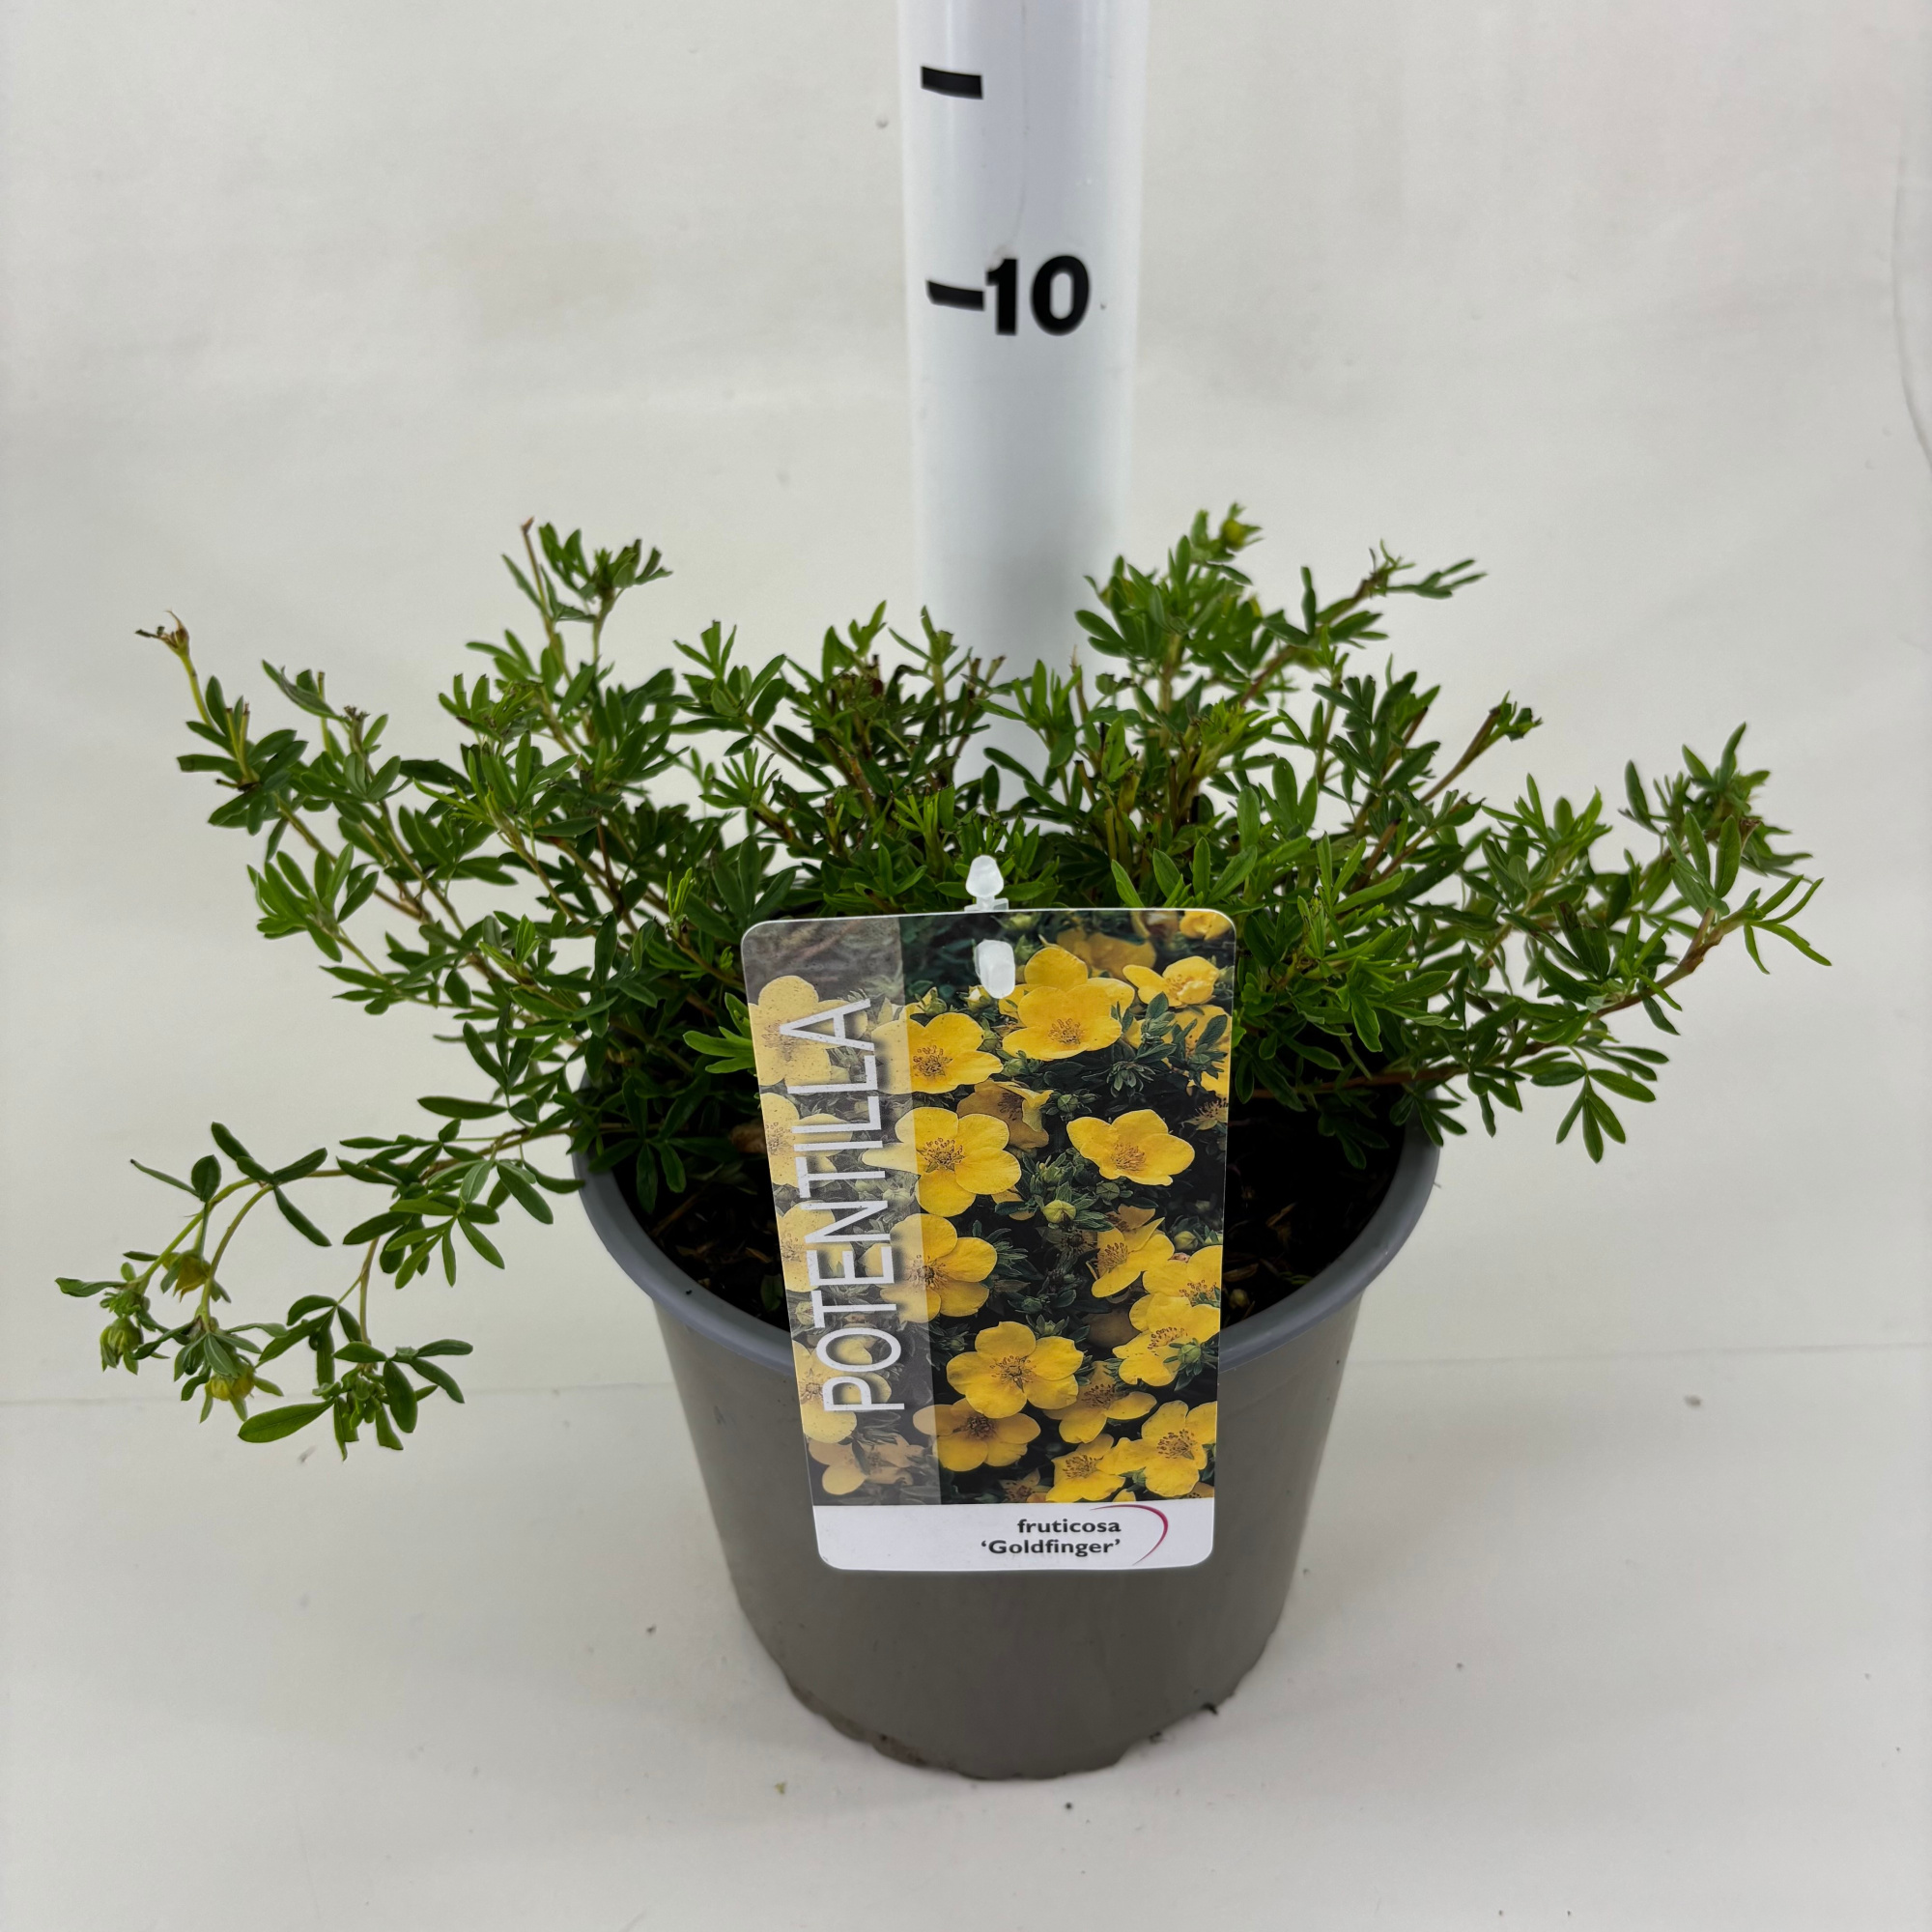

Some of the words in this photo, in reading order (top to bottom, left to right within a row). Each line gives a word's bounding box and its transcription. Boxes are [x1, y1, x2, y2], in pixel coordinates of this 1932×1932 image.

[985, 255, 1091, 336] 10
[779, 998, 905, 1412] POTENTILLA
[1017, 1519, 1122, 1533] fruticosa
